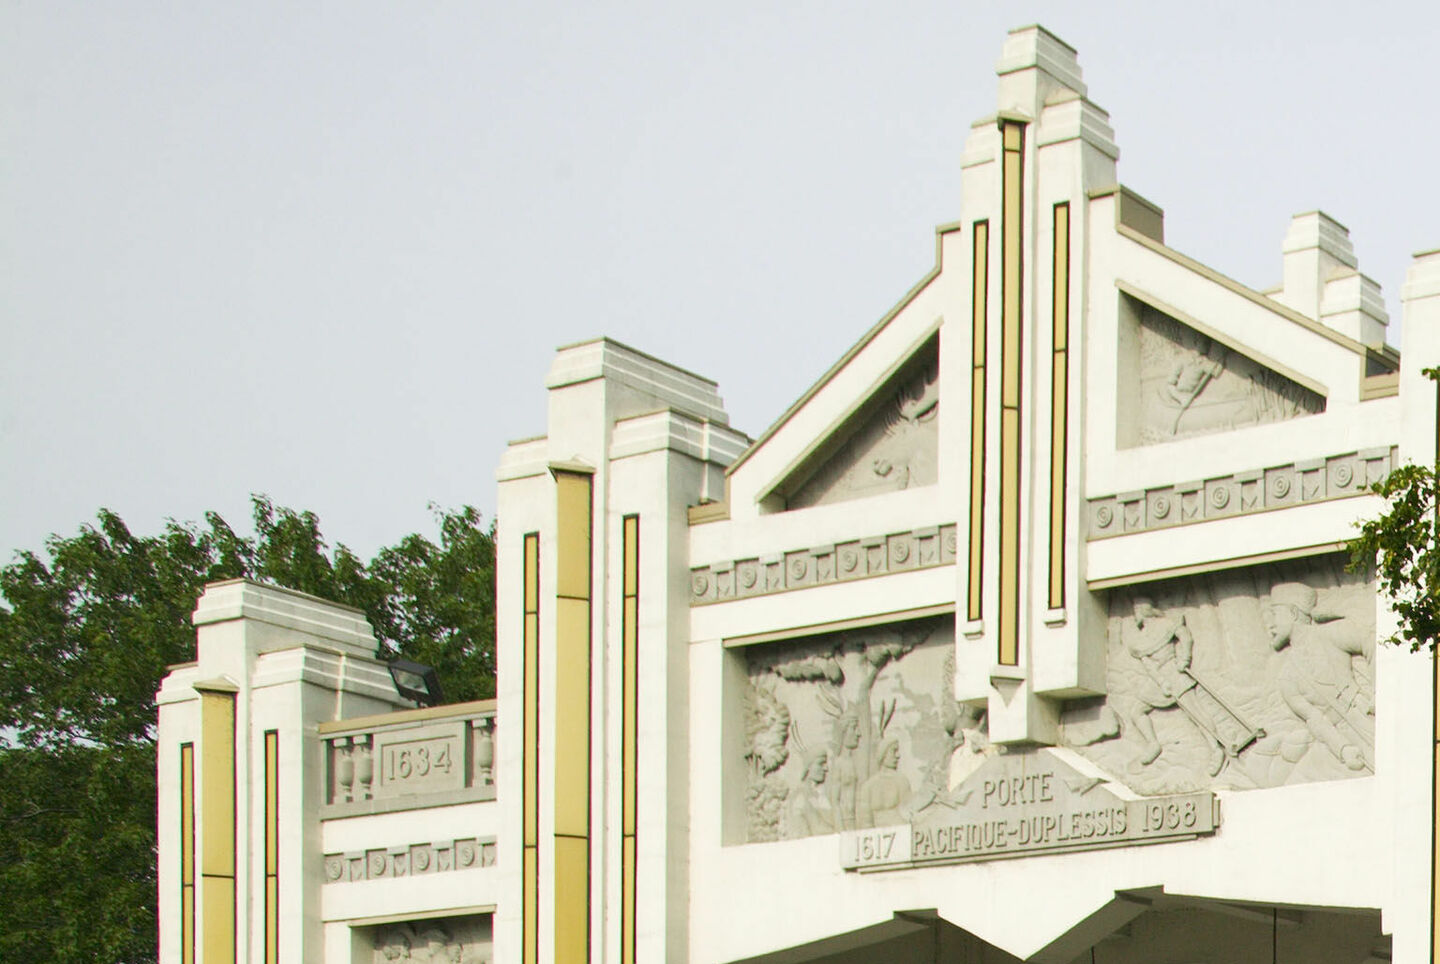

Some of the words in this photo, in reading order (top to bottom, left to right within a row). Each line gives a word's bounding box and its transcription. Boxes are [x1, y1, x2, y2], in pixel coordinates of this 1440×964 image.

[389, 743, 452, 781] 1634
[982, 771, 1054, 809] PORTE
[854, 832, 896, 862] 1617
[1142, 801, 1197, 833] 1938
